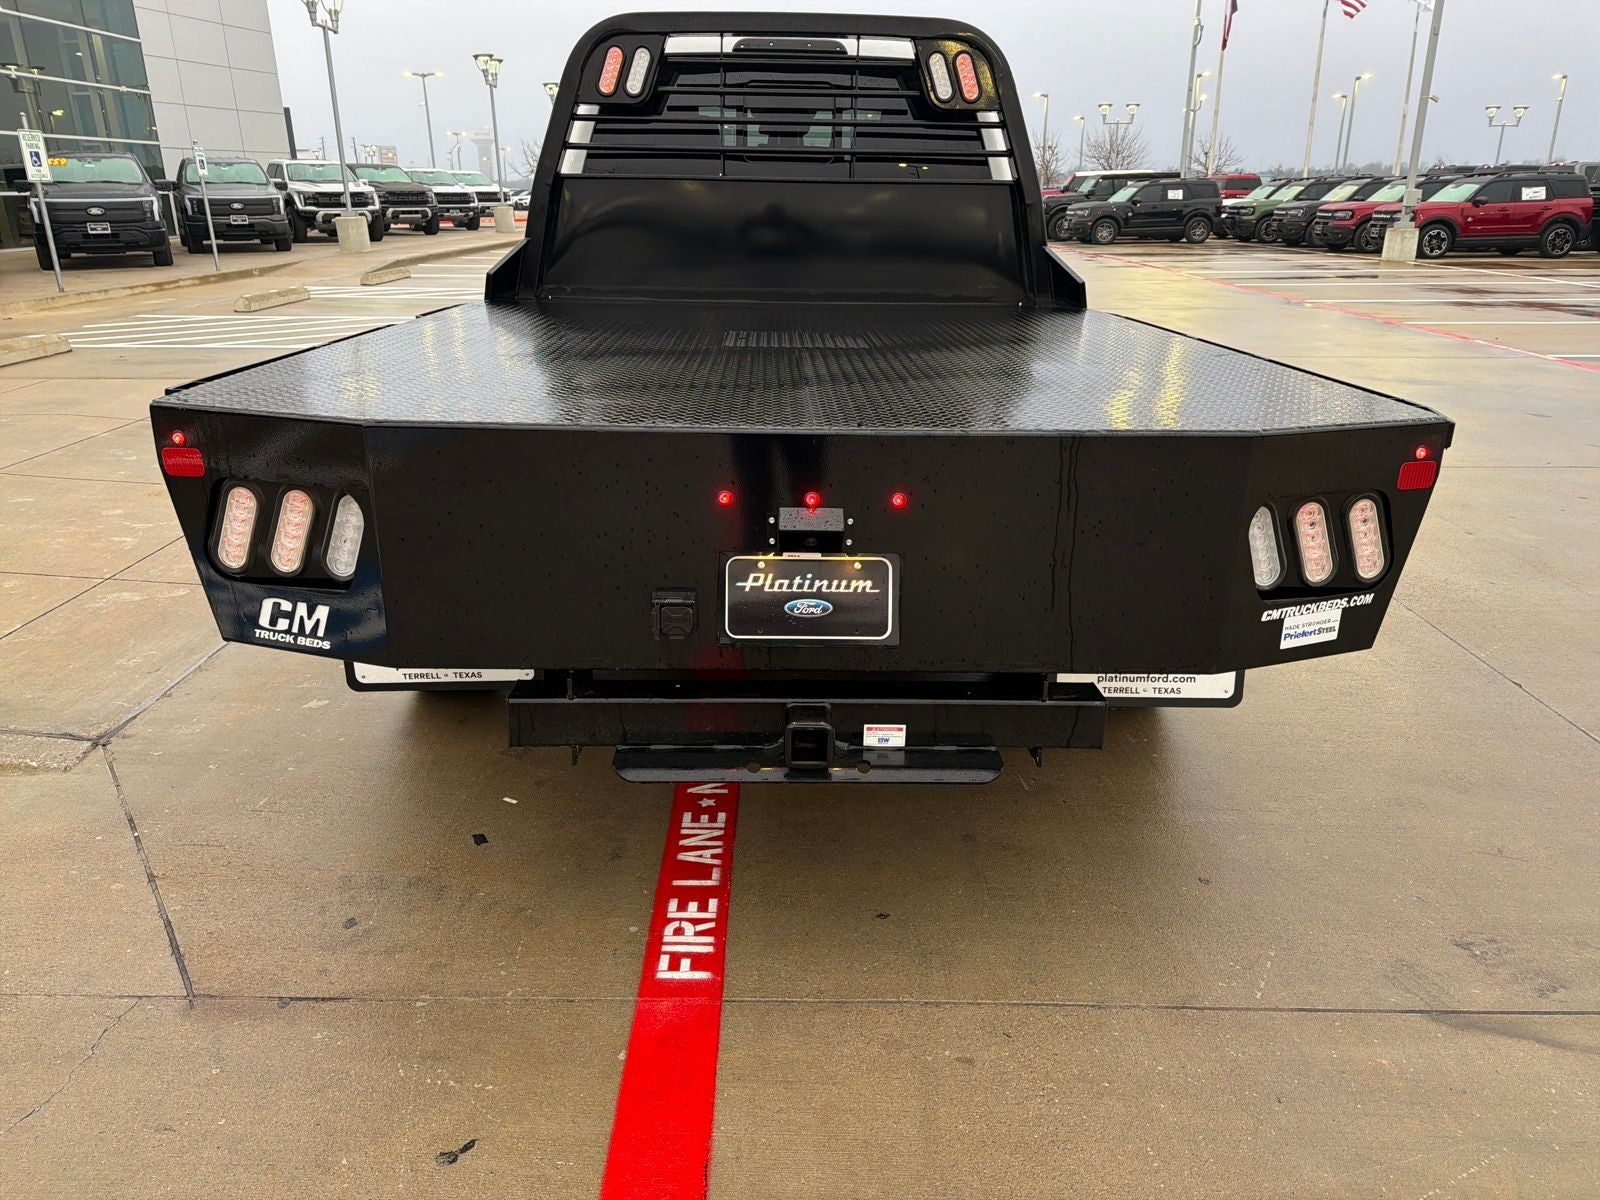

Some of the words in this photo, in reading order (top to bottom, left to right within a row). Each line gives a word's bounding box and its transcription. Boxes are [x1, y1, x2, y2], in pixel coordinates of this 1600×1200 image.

[735, 573, 881, 593] Platinum
[258, 597, 330, 638] CM
[793, 602, 823, 615] Ford
[1260, 593, 1375, 622] CMTRUCKBEDS.COM
[1301, 619, 1331, 629] STRONGER
[254, 628, 295, 644] TRUCK
[296, 636, 331, 650] BEDS
[453, 671, 483, 679] TEXAS
[1097, 674, 1196, 684] platinumford.com
[1102, 686, 1140, 695] TERRELL
[1152, 687, 1182, 695] TEXAS
[671, 812, 727, 886] LANE
[655, 898, 719, 980] FIRE
